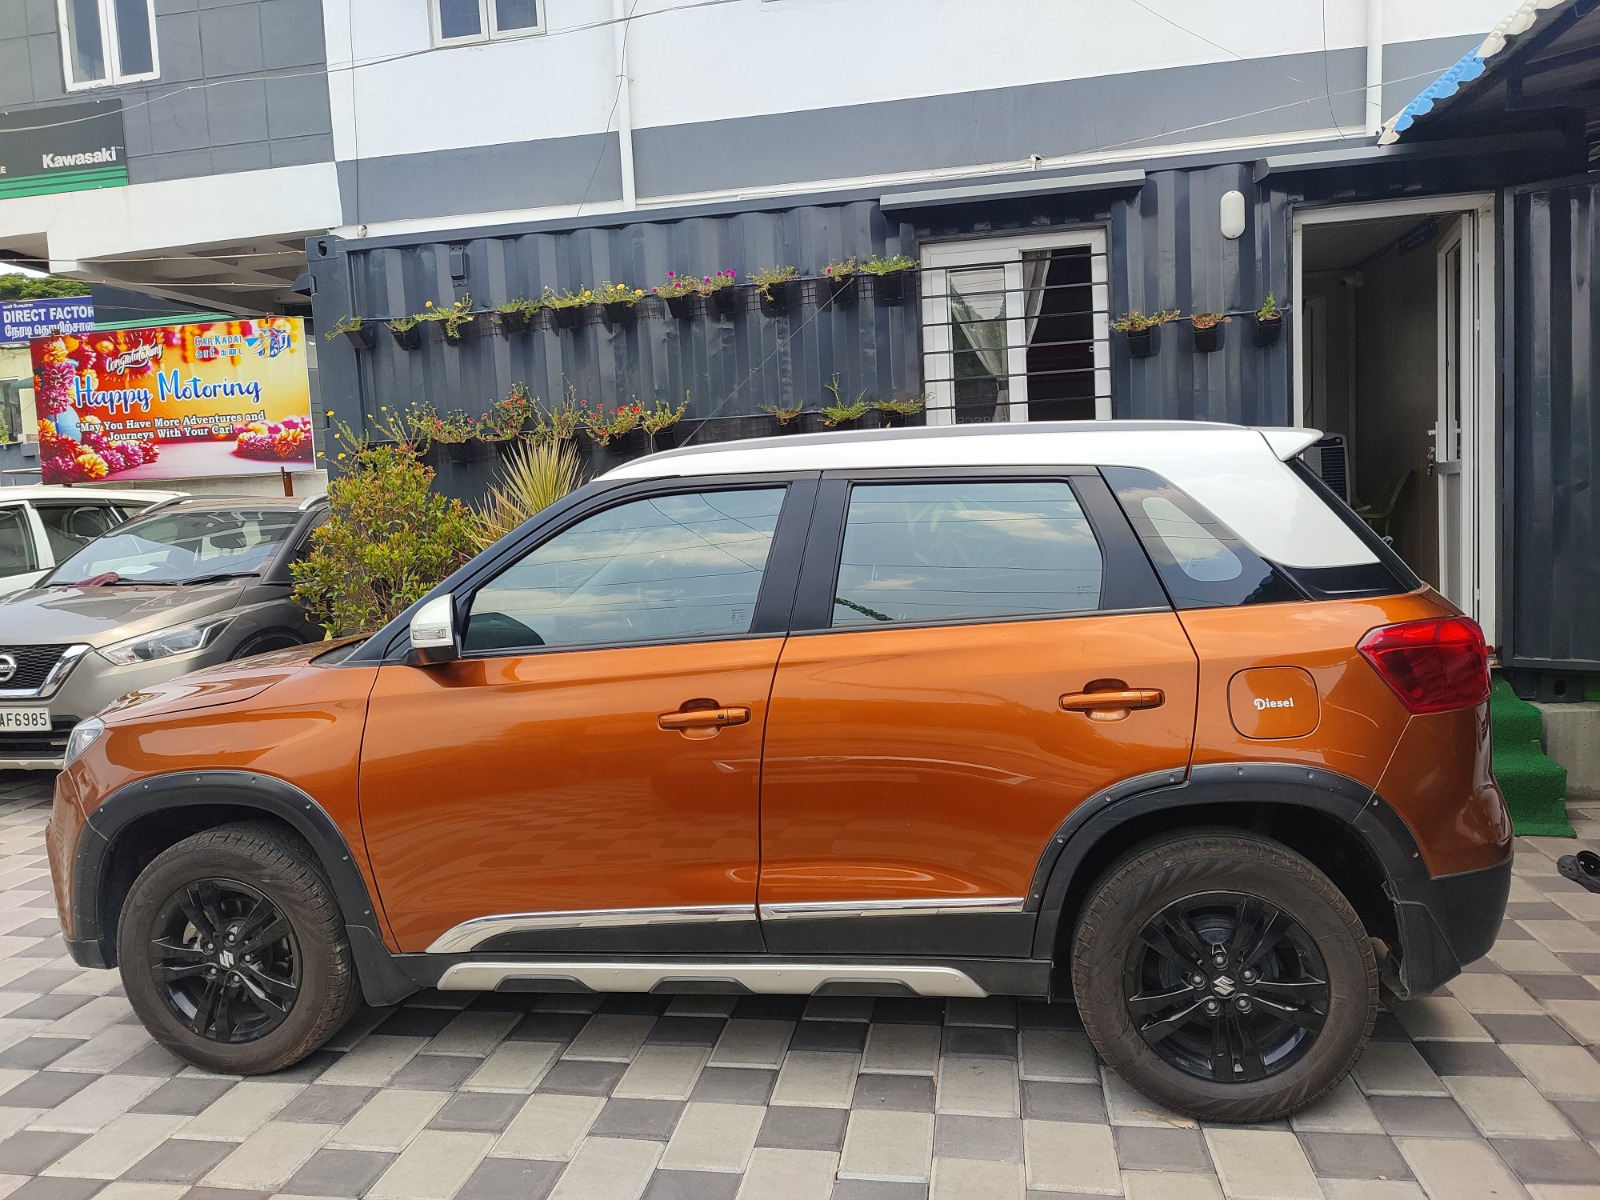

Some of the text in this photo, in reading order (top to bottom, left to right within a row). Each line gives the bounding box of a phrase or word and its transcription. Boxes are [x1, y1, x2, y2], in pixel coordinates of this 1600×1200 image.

[42, 146, 117, 169] Kawasaki
[3, 308, 46, 324] DIRECT
[49, 305, 95, 320] FACTOR
[74, 369, 262, 414] Happy Motoring
[103, 421, 124, 431] You
[125, 419, 152, 429] Have
[154, 417, 180, 428] More
[183, 413, 243, 426] Adventures
[244, 410, 266, 422] and
[107, 423, 234, 442] Journeys With Your Car!
[1253, 697, 1295, 711] Diesel
[0, 712, 48, 728] AF6985
